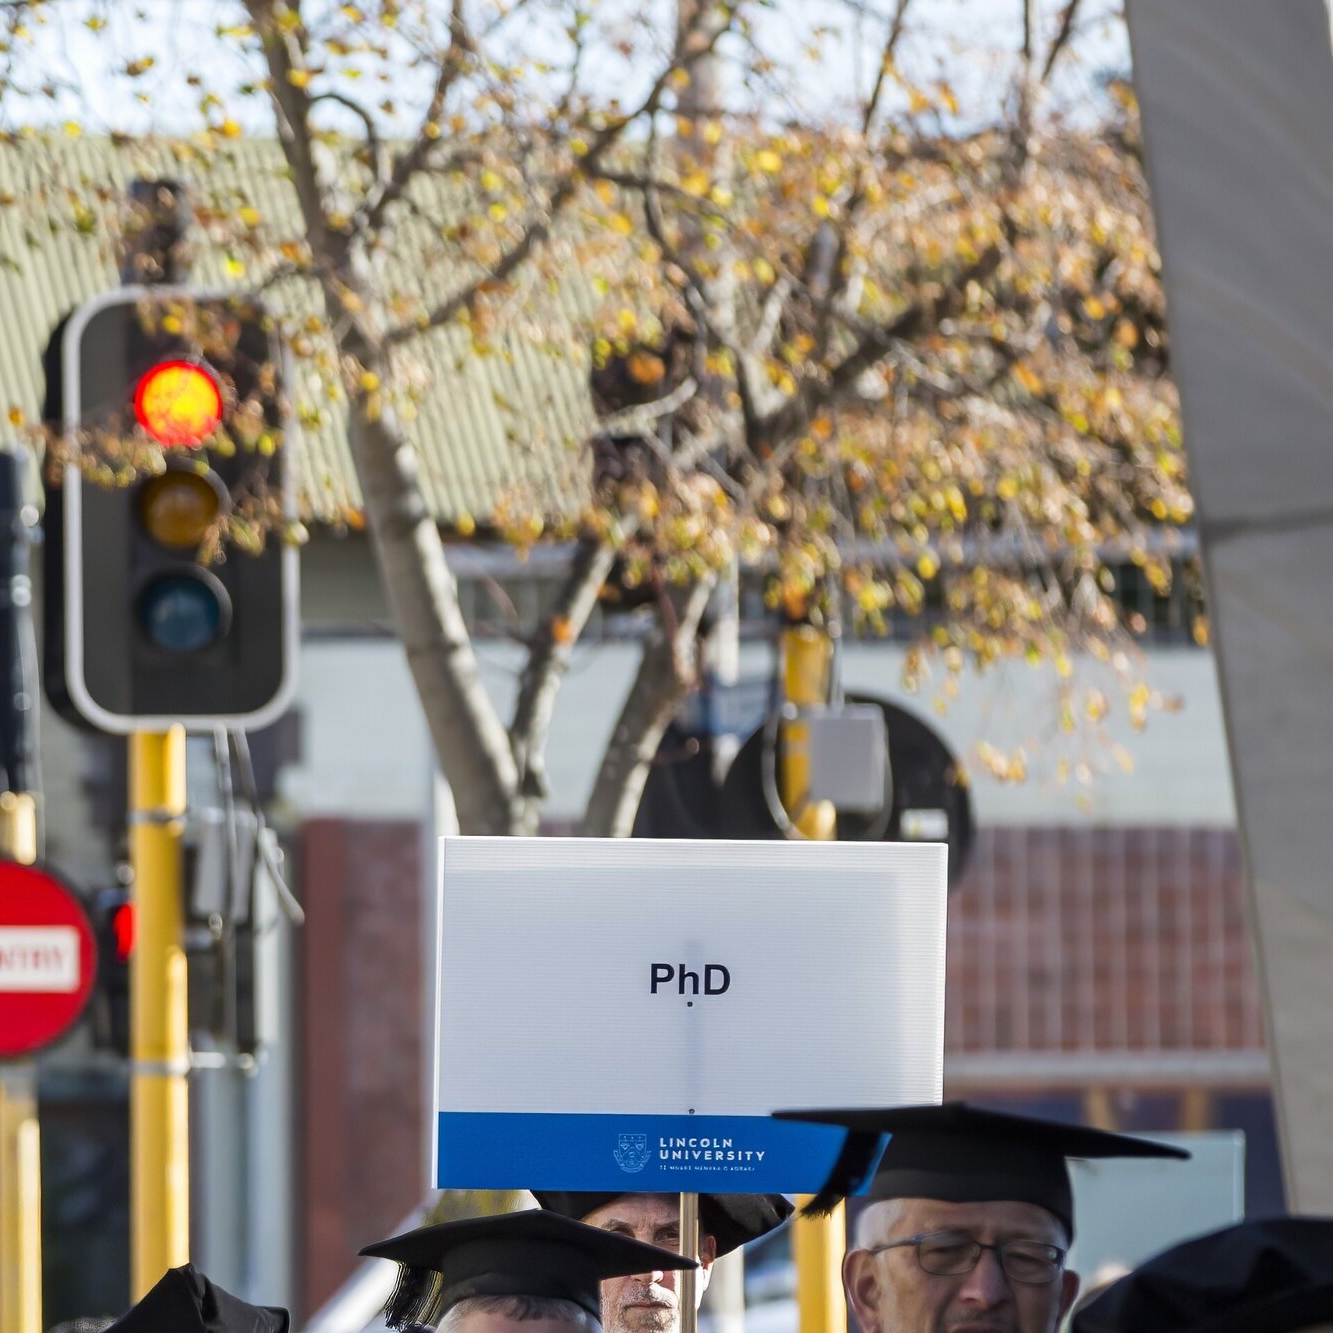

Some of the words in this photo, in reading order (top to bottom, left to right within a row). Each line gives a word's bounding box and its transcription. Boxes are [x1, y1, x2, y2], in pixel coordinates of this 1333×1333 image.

[650, 963, 731, 995] PhD
[659, 1137, 732, 1148] LINCOLN
[659, 1150, 765, 1161] UNIVERSITY
